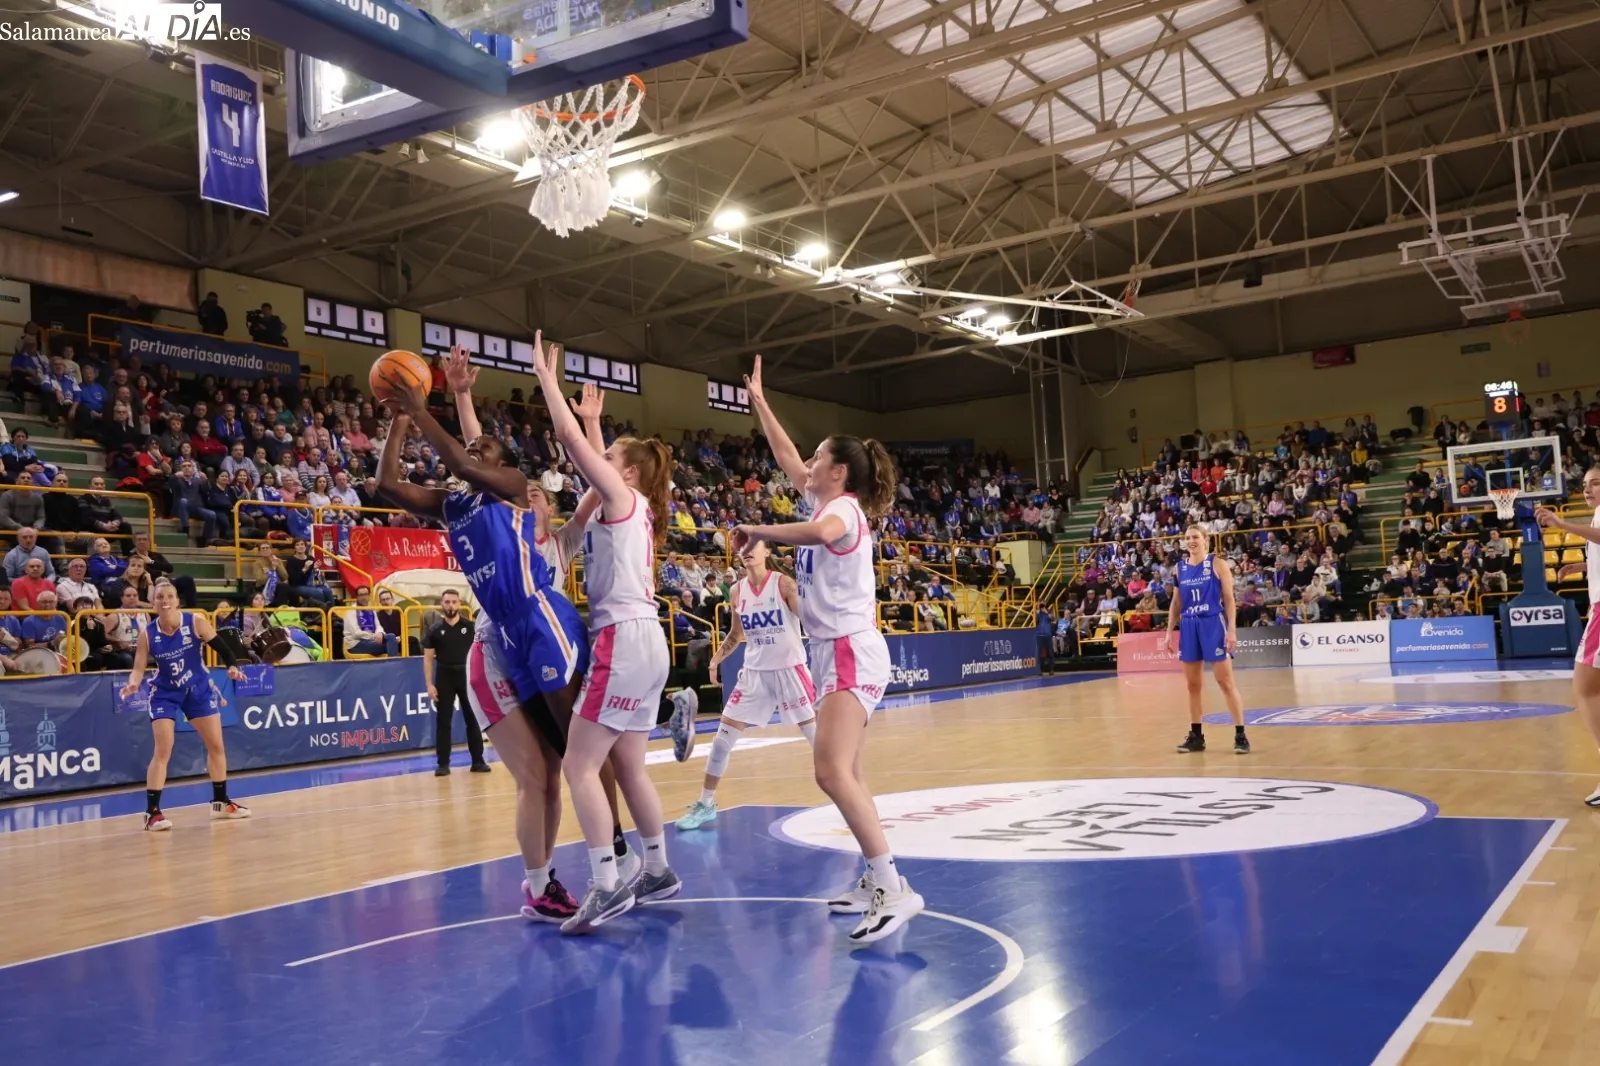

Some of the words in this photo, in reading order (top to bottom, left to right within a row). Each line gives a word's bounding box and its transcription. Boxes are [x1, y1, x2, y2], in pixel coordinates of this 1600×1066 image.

[222, 102, 240, 147] 4
[129, 338, 292, 375] perfumeriasavenida.com
[1494, 397, 1507, 413] 8
[387, 536, 400, 557] La
[458, 535, 474, 562] 3
[1191, 588, 1201, 602] 11
[740, 609, 784, 630] BAXI
[1236, 638, 1290, 647] SCHLESSER
[1317, 635, 1333, 645] EL
[1336, 633, 1385, 645] GANSO
[1396, 642, 1489, 653] perfumeriasavenida.com
[170, 658, 185, 676] 30
[961, 656, 1036, 679] perfumeriasavenida.com
[243, 698, 369, 730] CASTILLA
[380, 695, 396, 723] Y
[310, 732, 339, 748] NOS
[341, 725, 409, 750] IMPULSA
